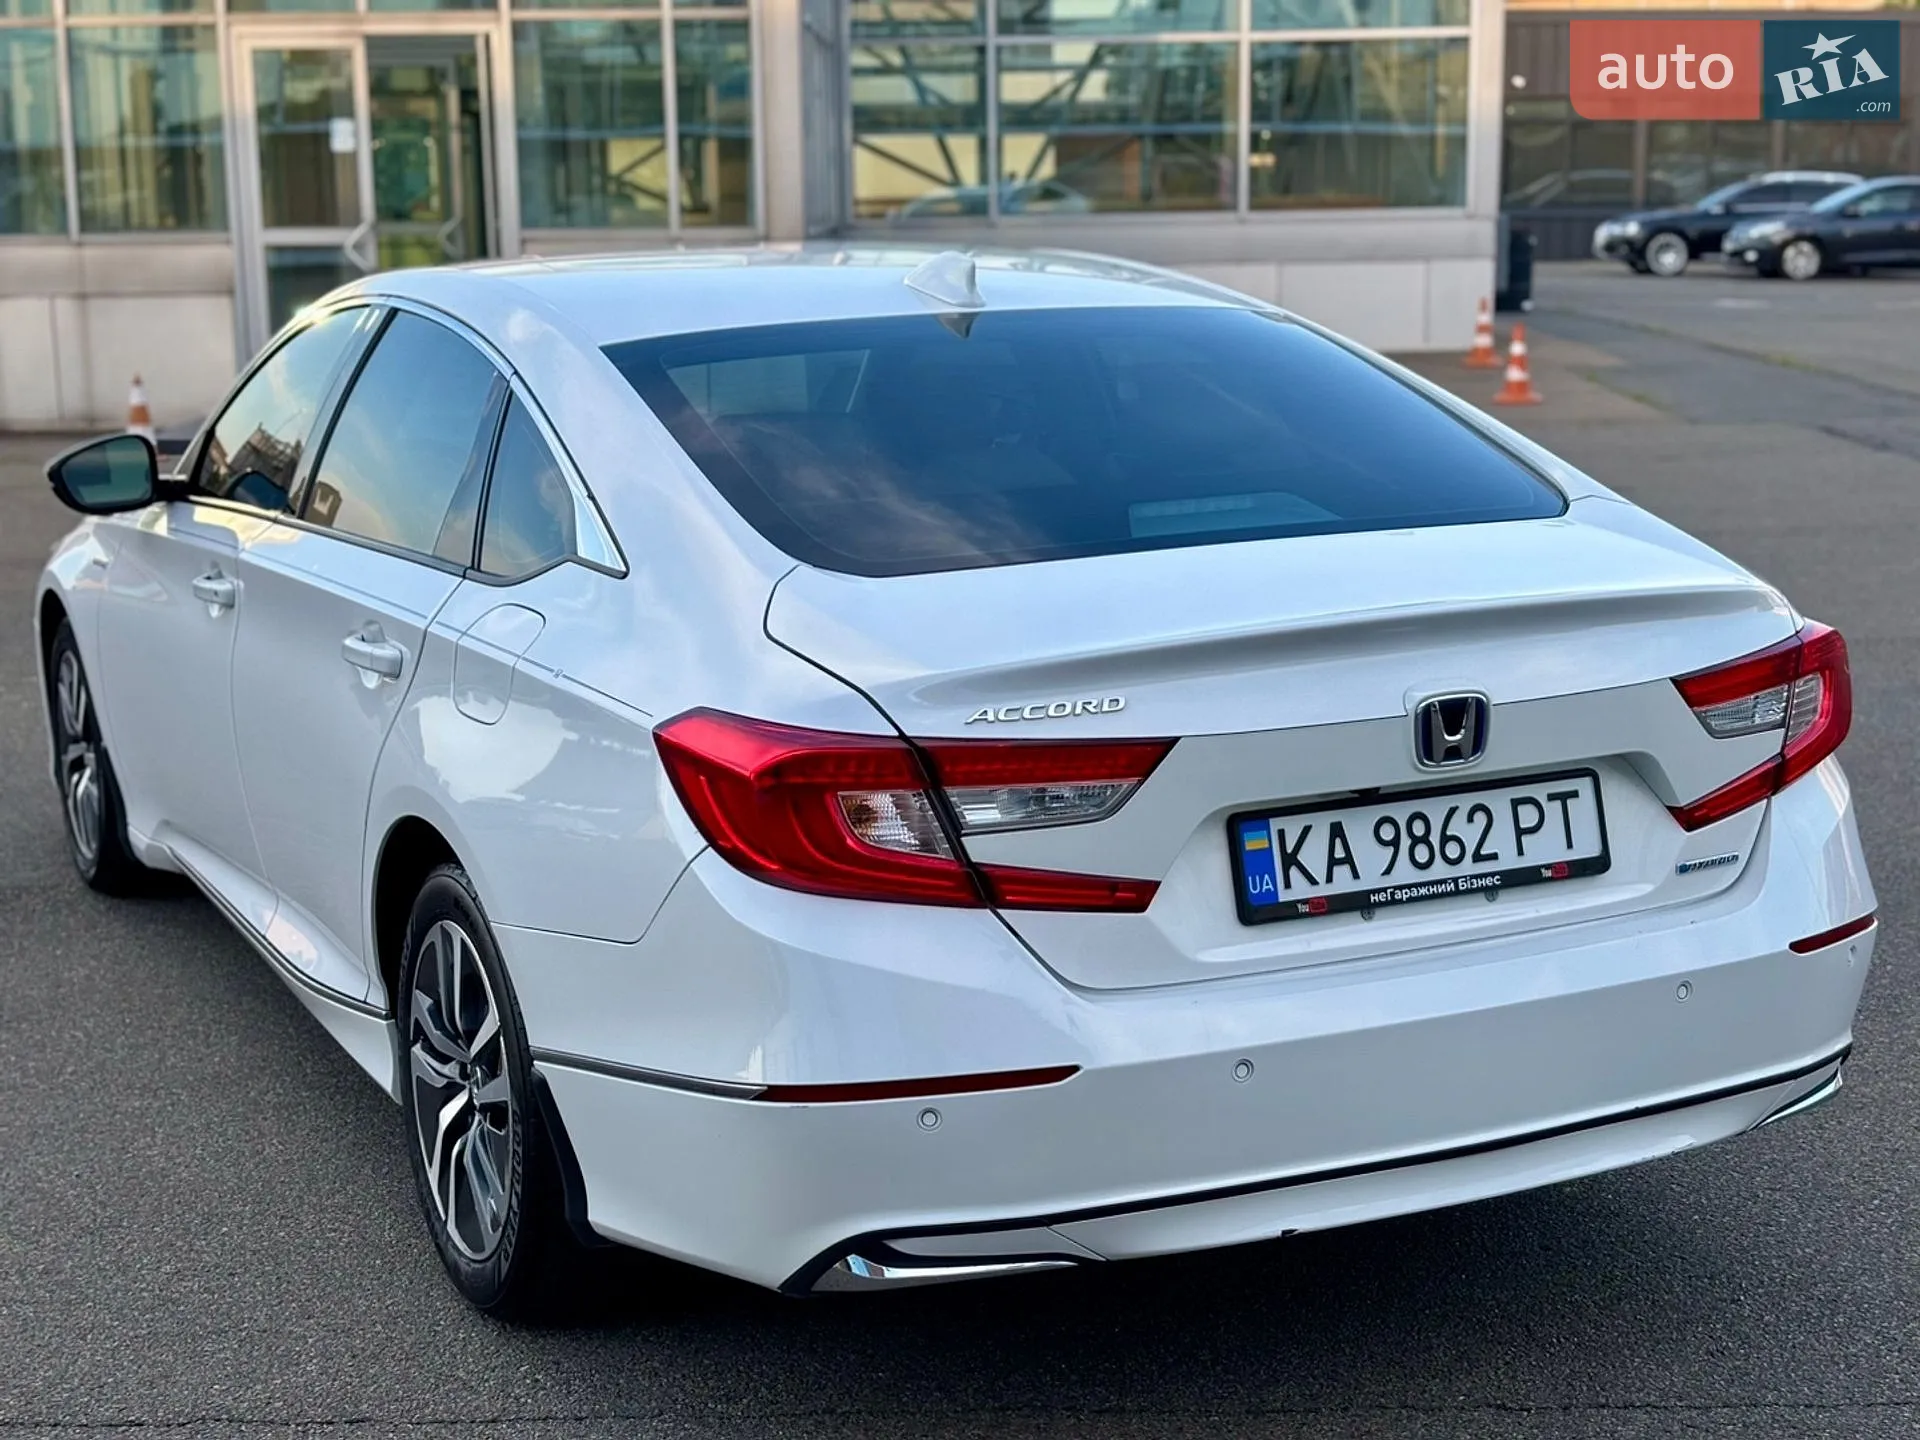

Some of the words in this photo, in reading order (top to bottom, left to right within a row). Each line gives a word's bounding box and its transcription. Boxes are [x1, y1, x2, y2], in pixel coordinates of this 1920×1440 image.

[964, 695, 1127, 725] ACCORD
[1277, 820, 1362, 891] KA
[1373, 803, 1499, 876] 9862
[1510, 789, 1580, 857] PT
[1248, 873, 1275, 894] UA
[1370, 879, 1455, 903] неГаражний
[1458, 874, 1502, 891] Бізнес
